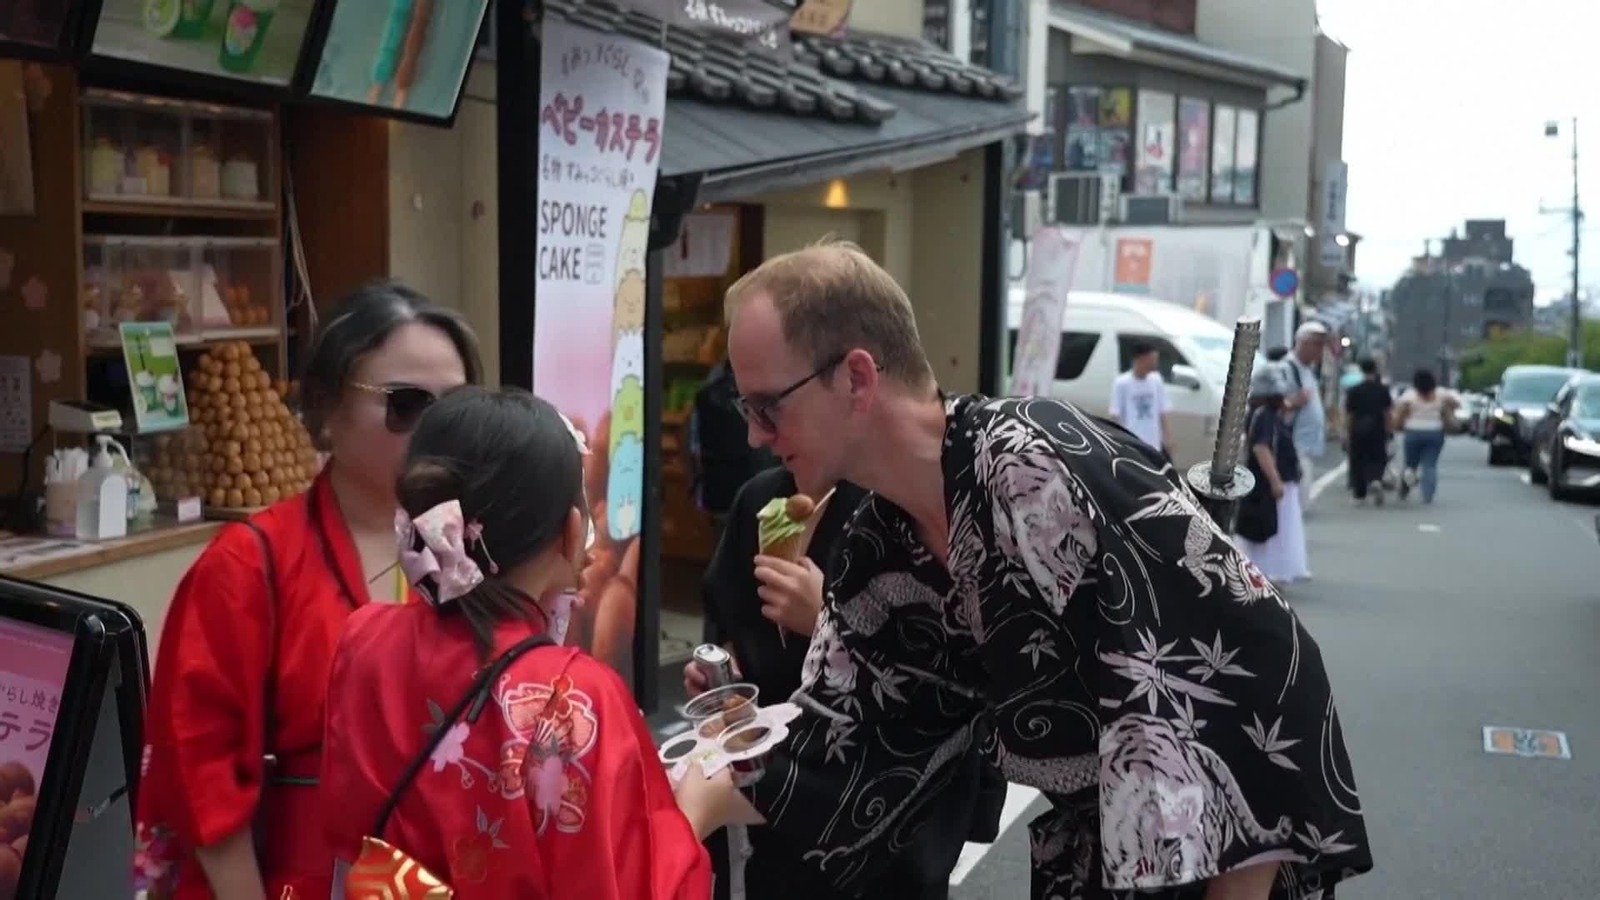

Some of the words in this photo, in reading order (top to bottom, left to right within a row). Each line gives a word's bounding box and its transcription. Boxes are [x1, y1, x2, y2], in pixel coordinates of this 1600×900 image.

[541, 200, 608, 238] SPONGE
[540, 246, 582, 280] CAKE
[0, 683, 59, 714] らし焼き
